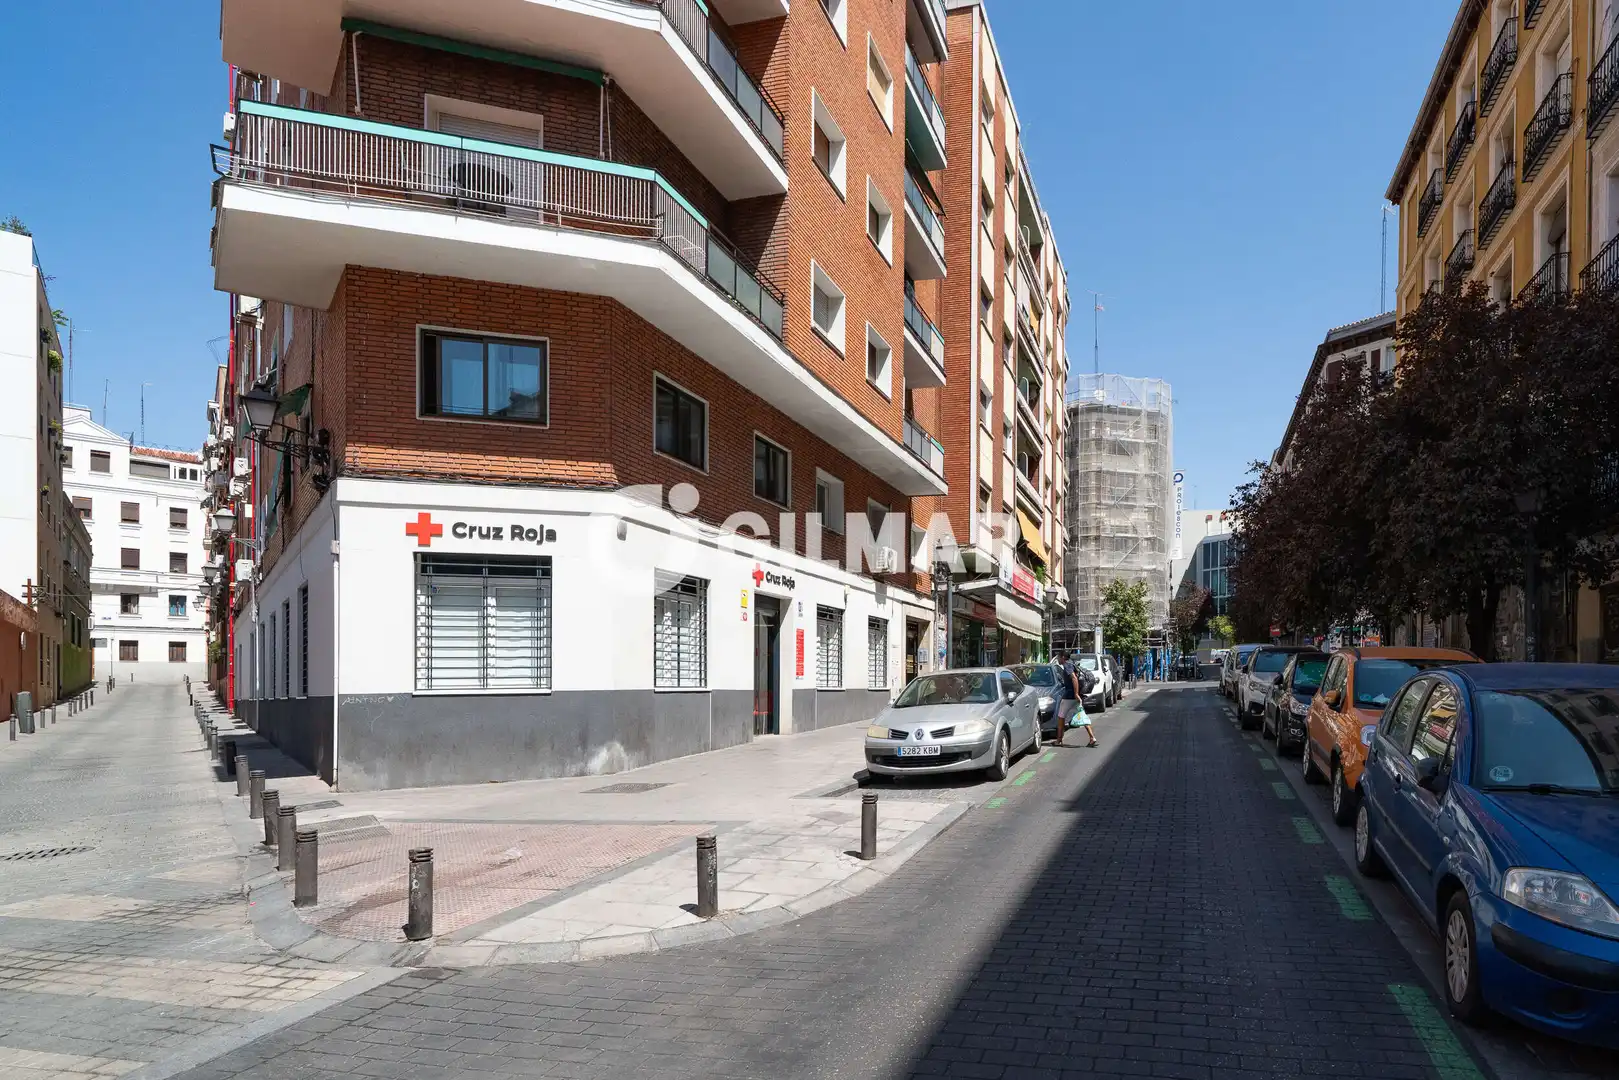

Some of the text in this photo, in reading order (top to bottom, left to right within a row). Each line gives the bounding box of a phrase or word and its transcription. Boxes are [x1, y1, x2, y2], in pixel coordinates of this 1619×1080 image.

[451, 521, 557, 546] Cruz Roja
[765, 571, 796, 591] Cruz Roja
[902, 746, 939, 756] 5282 KBM
